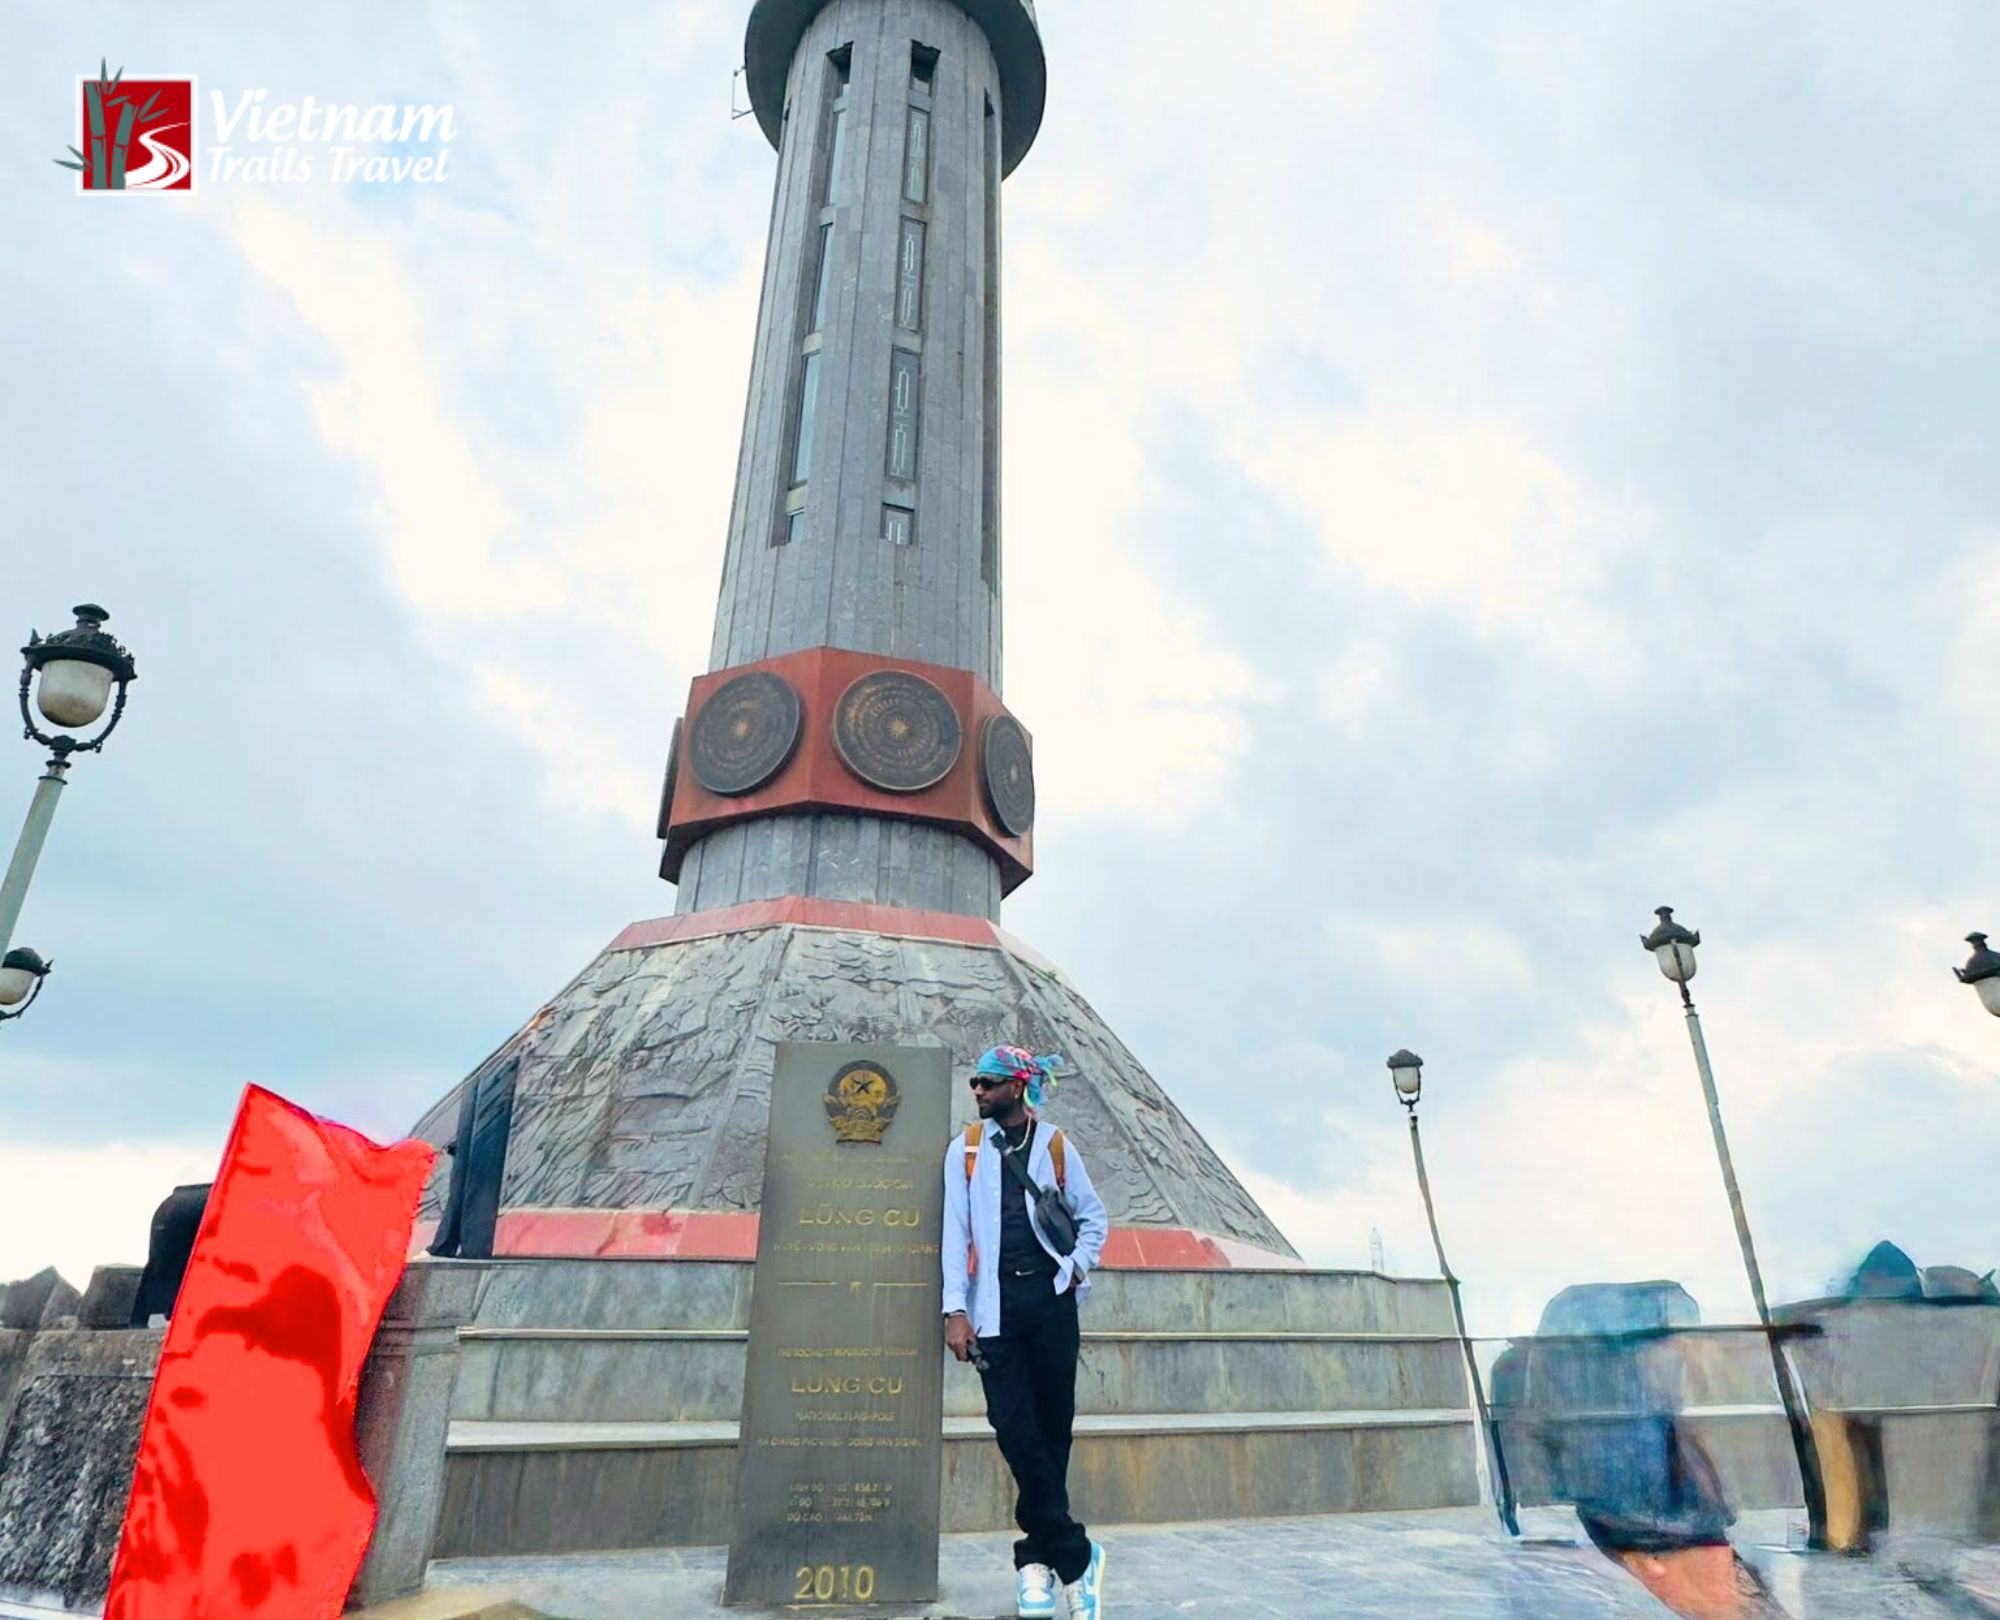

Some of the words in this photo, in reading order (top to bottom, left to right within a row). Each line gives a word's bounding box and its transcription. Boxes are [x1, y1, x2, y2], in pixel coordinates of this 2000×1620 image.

[791, 1375, 861, 1394] LUNG
[869, 1376, 904, 1395] CU
[794, 1565, 876, 1600] 2010
